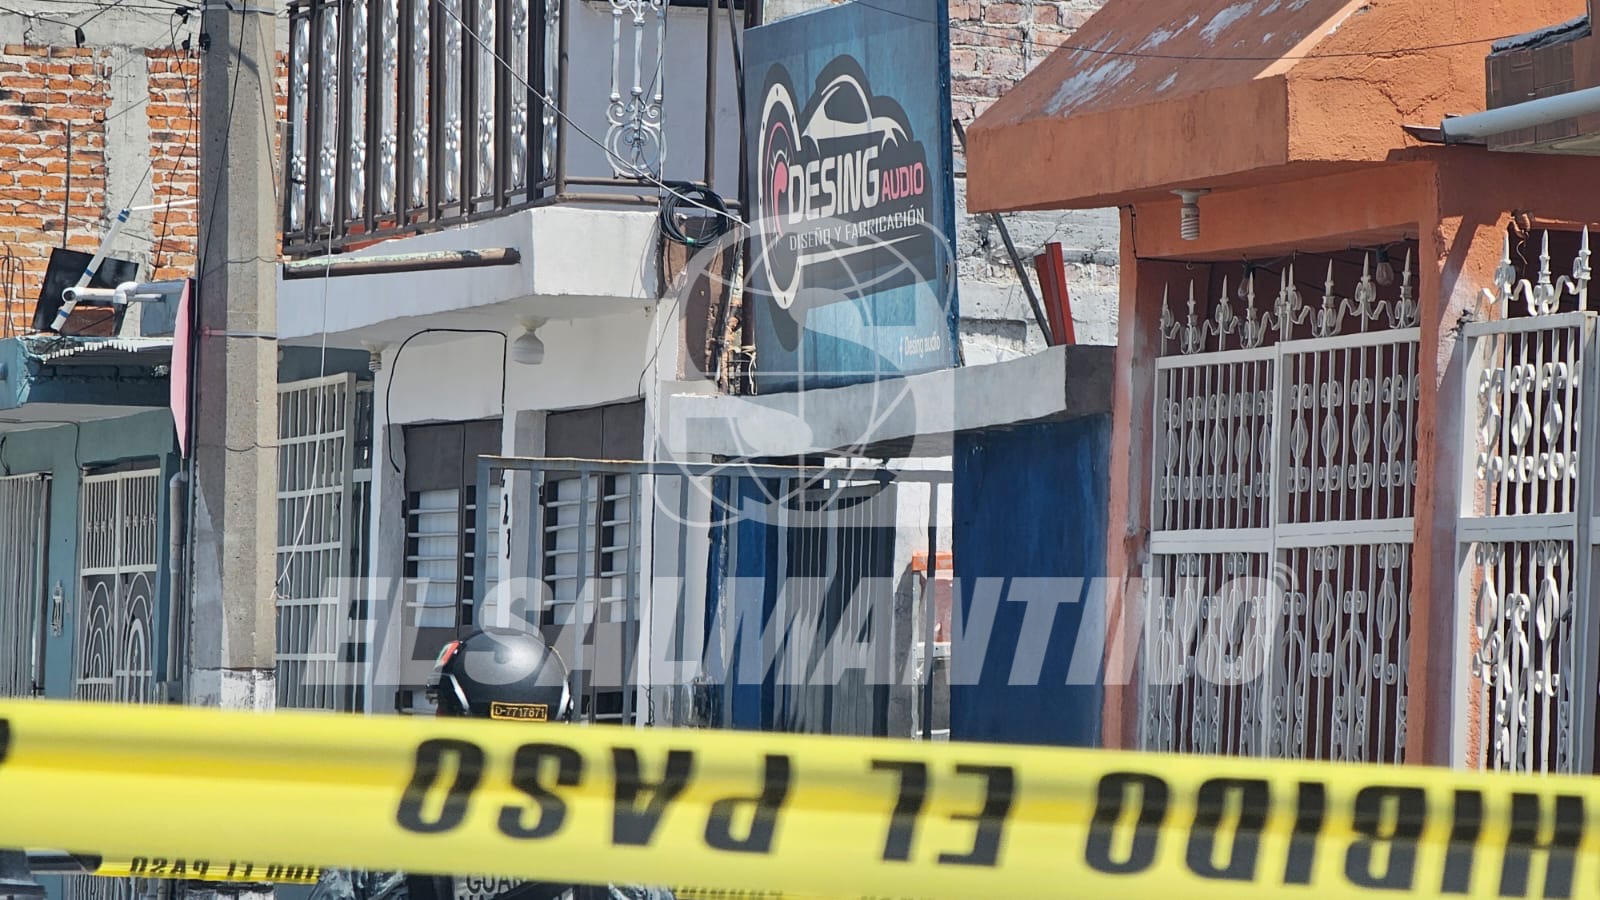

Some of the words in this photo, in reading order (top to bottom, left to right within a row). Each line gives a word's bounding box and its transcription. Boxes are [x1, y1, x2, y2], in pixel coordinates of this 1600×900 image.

[788, 145, 880, 225] DESING
[881, 161, 924, 203] AUDIO
[789, 226, 831, 251] DISEÑO
[834, 226, 844, 243] Y
[845, 204, 926, 241] FABRICACIÓN
[396, 737, 791, 854] PASO
[871, 758, 1016, 868] EL
